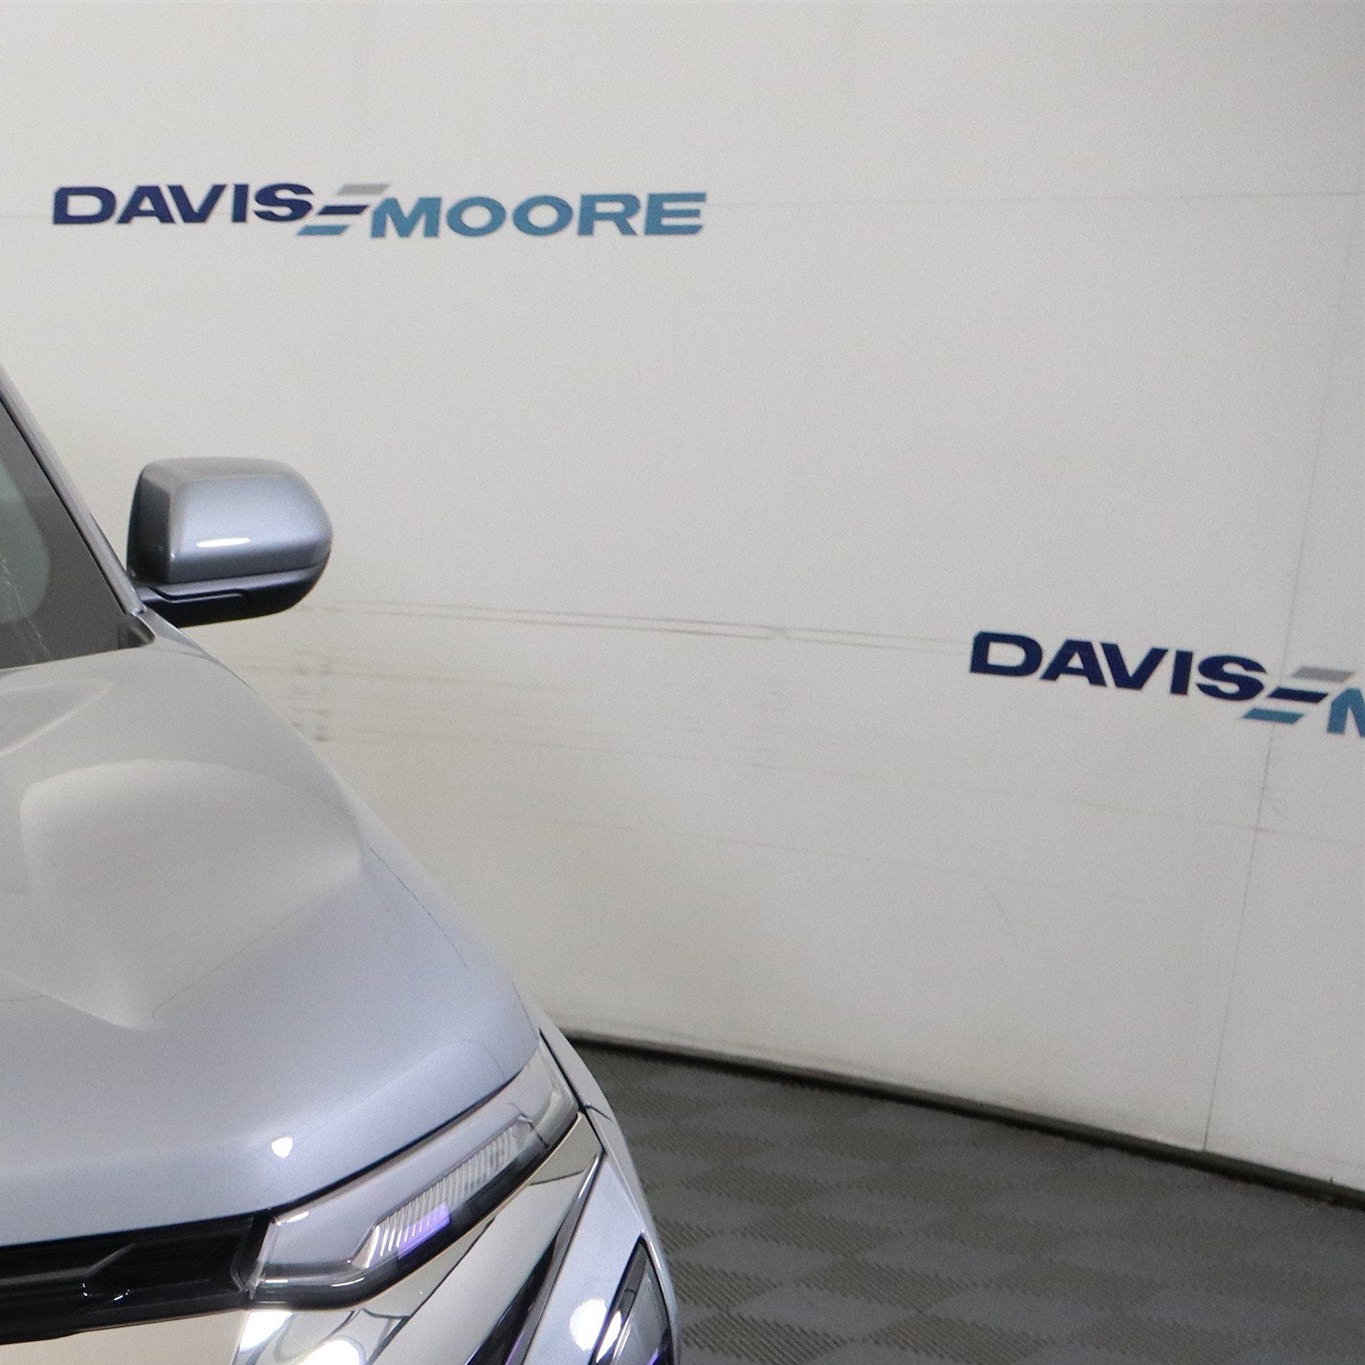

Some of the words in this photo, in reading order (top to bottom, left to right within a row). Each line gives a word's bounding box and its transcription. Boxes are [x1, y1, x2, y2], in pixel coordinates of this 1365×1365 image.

[52, 183, 314, 225] DAVIS
[370, 192, 706, 238] MOORE
[969, 631, 1267, 702] DAVIS
